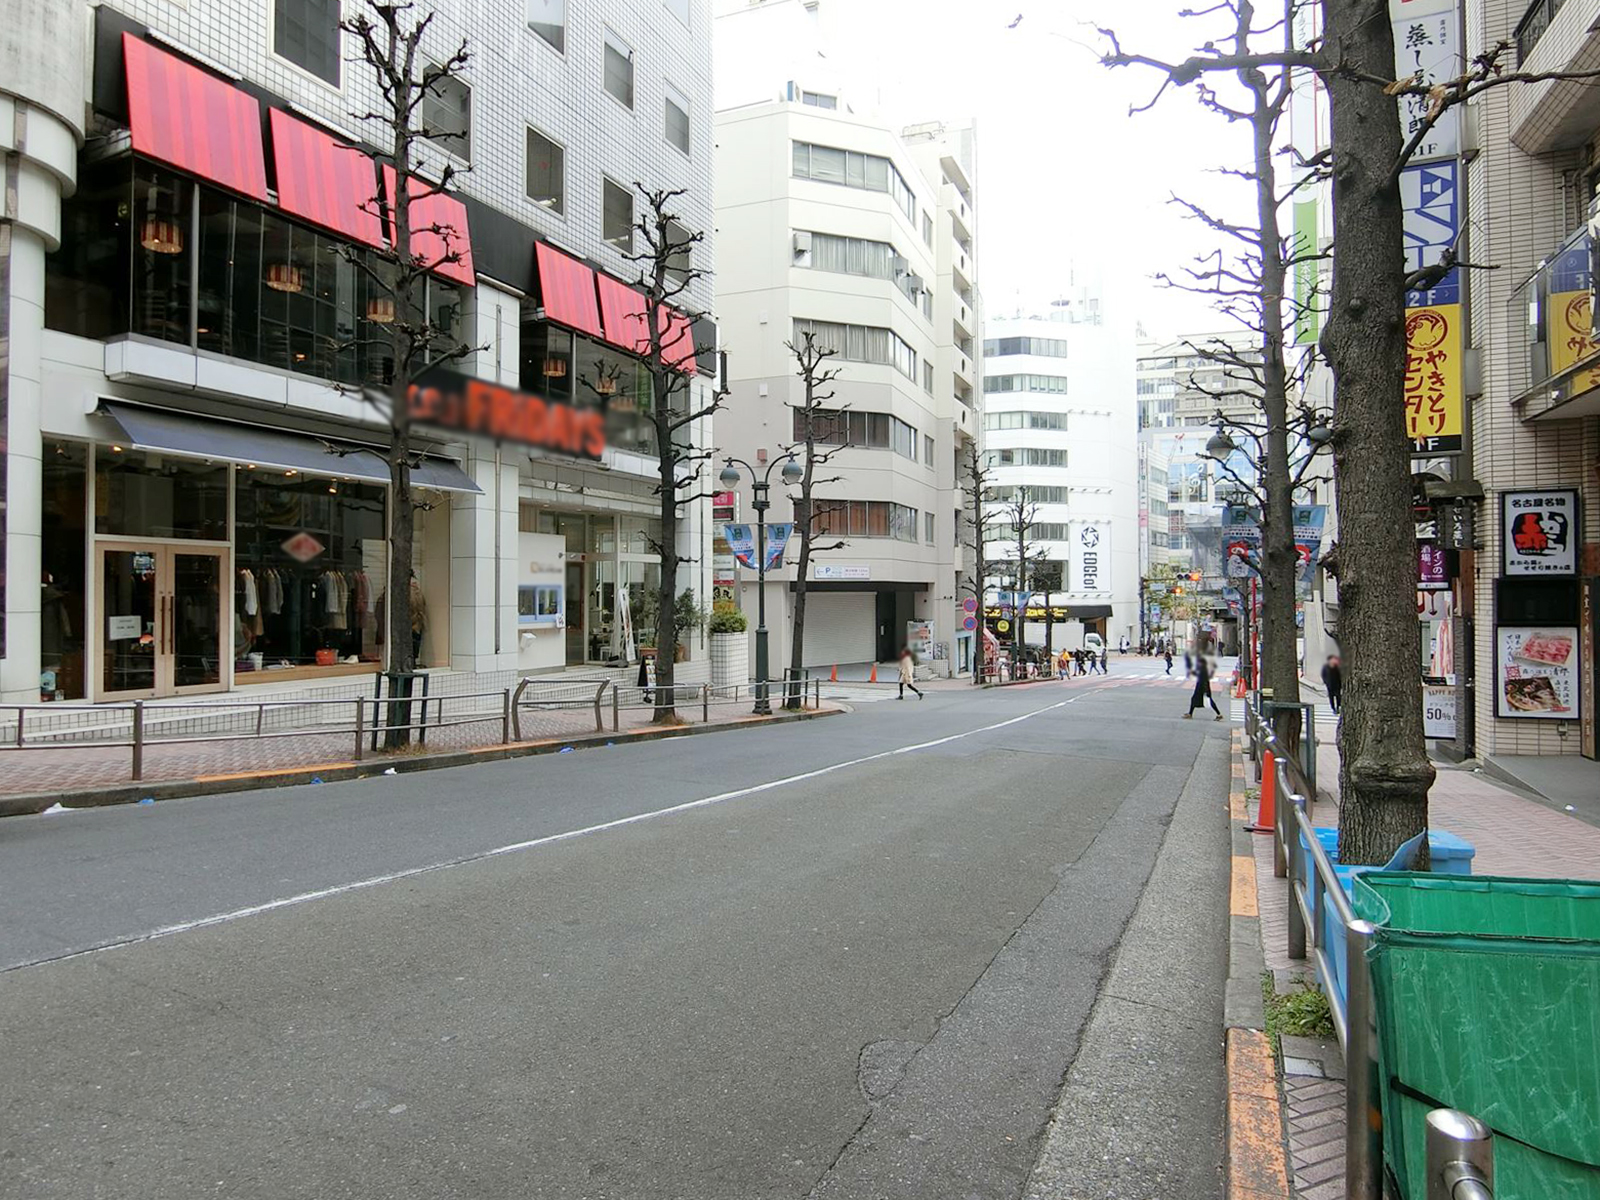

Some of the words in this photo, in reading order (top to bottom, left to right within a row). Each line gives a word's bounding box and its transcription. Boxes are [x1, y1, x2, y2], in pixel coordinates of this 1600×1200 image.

[1409, 289, 1436, 307] 2F
[1403, 353, 1424, 433] センター
[1425, 350, 1447, 434] やきとり
[1083, 552, 1098, 590] EDGEof
[1433, 547, 1444, 574] インの
[1426, 707, 1452, 721] 50%
